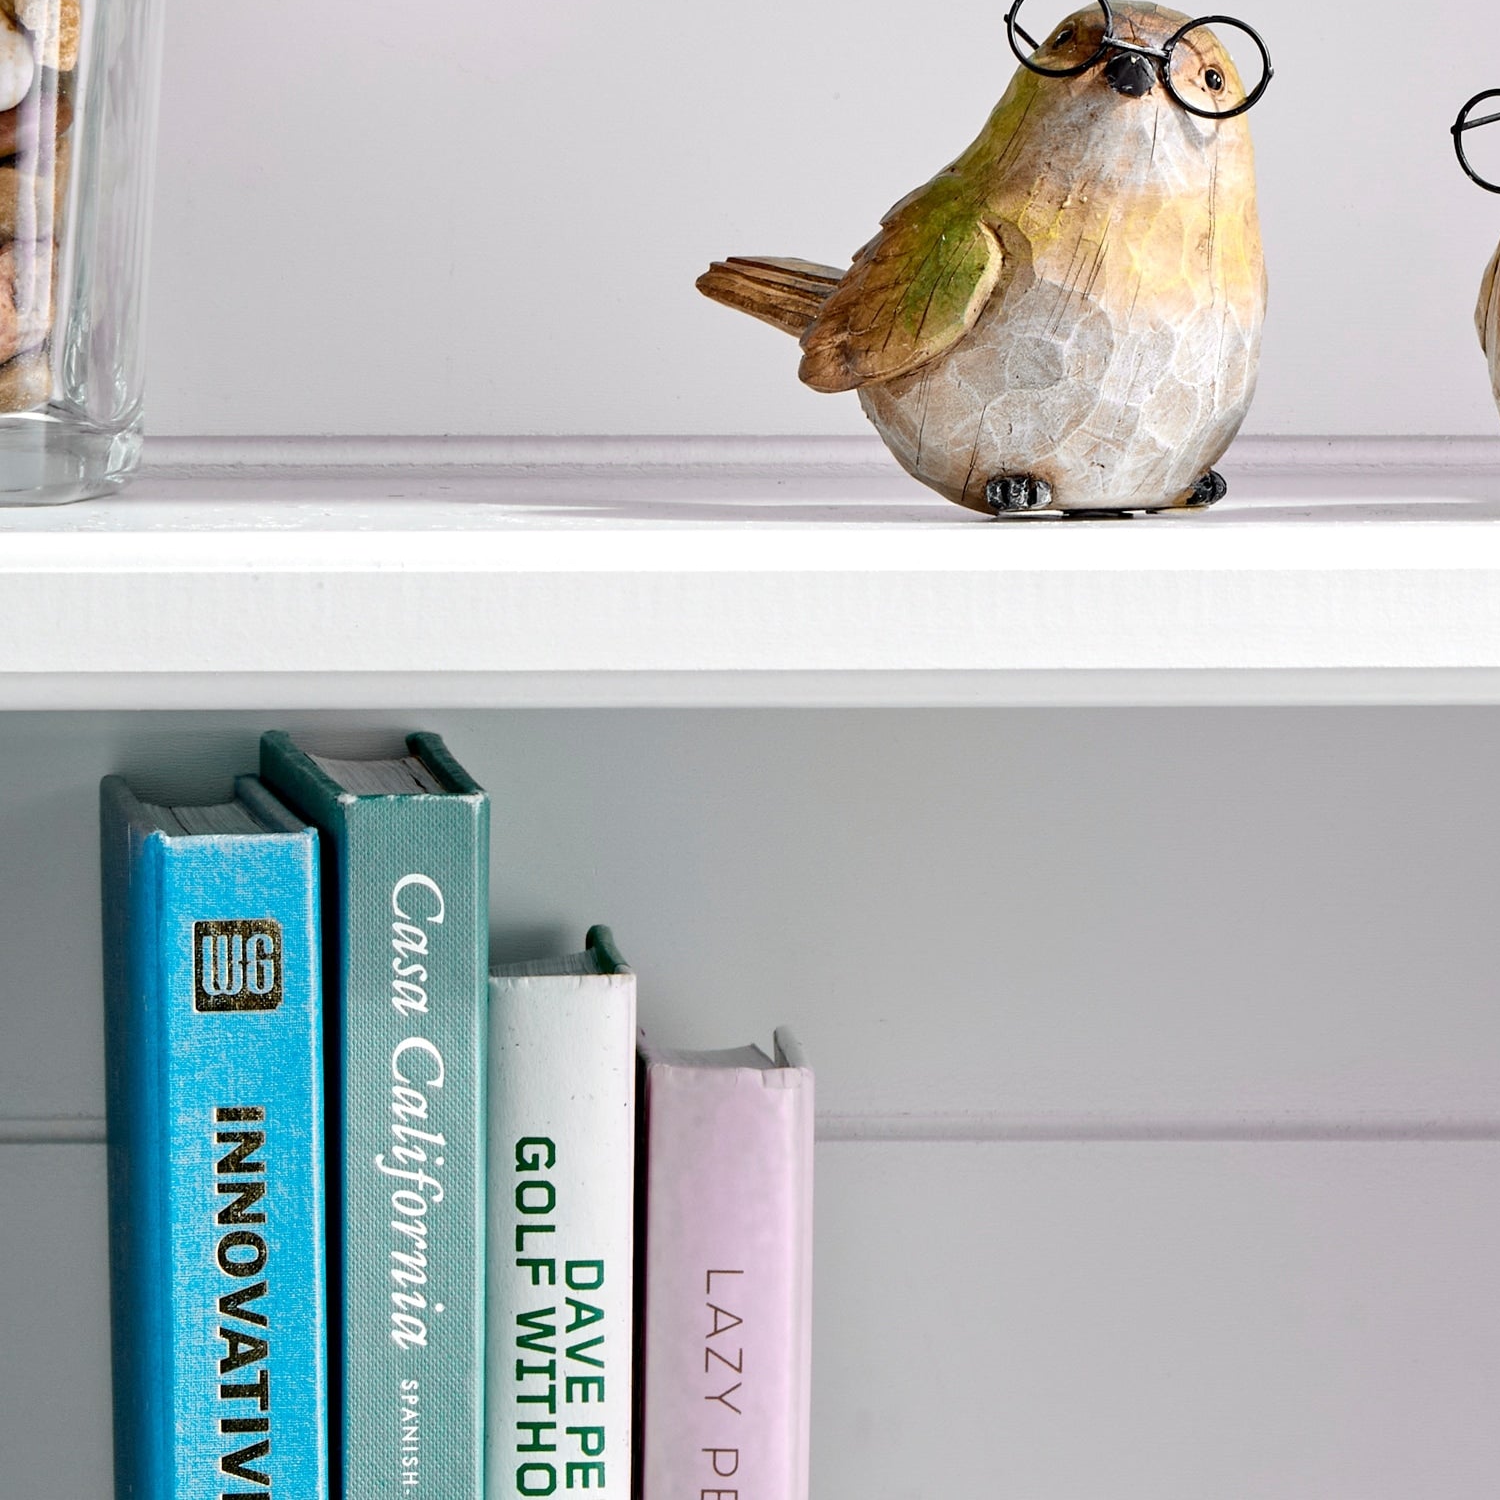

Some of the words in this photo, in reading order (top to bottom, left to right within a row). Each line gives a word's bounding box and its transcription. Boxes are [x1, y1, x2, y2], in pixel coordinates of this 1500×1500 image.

[391, 873, 445, 1018] Casa
[376, 1037, 445, 1351] California
[514, 1136, 556, 1286] GOLF
[565, 1260, 605, 1403] DAVE
[703, 1269, 745, 1416] LAZY
